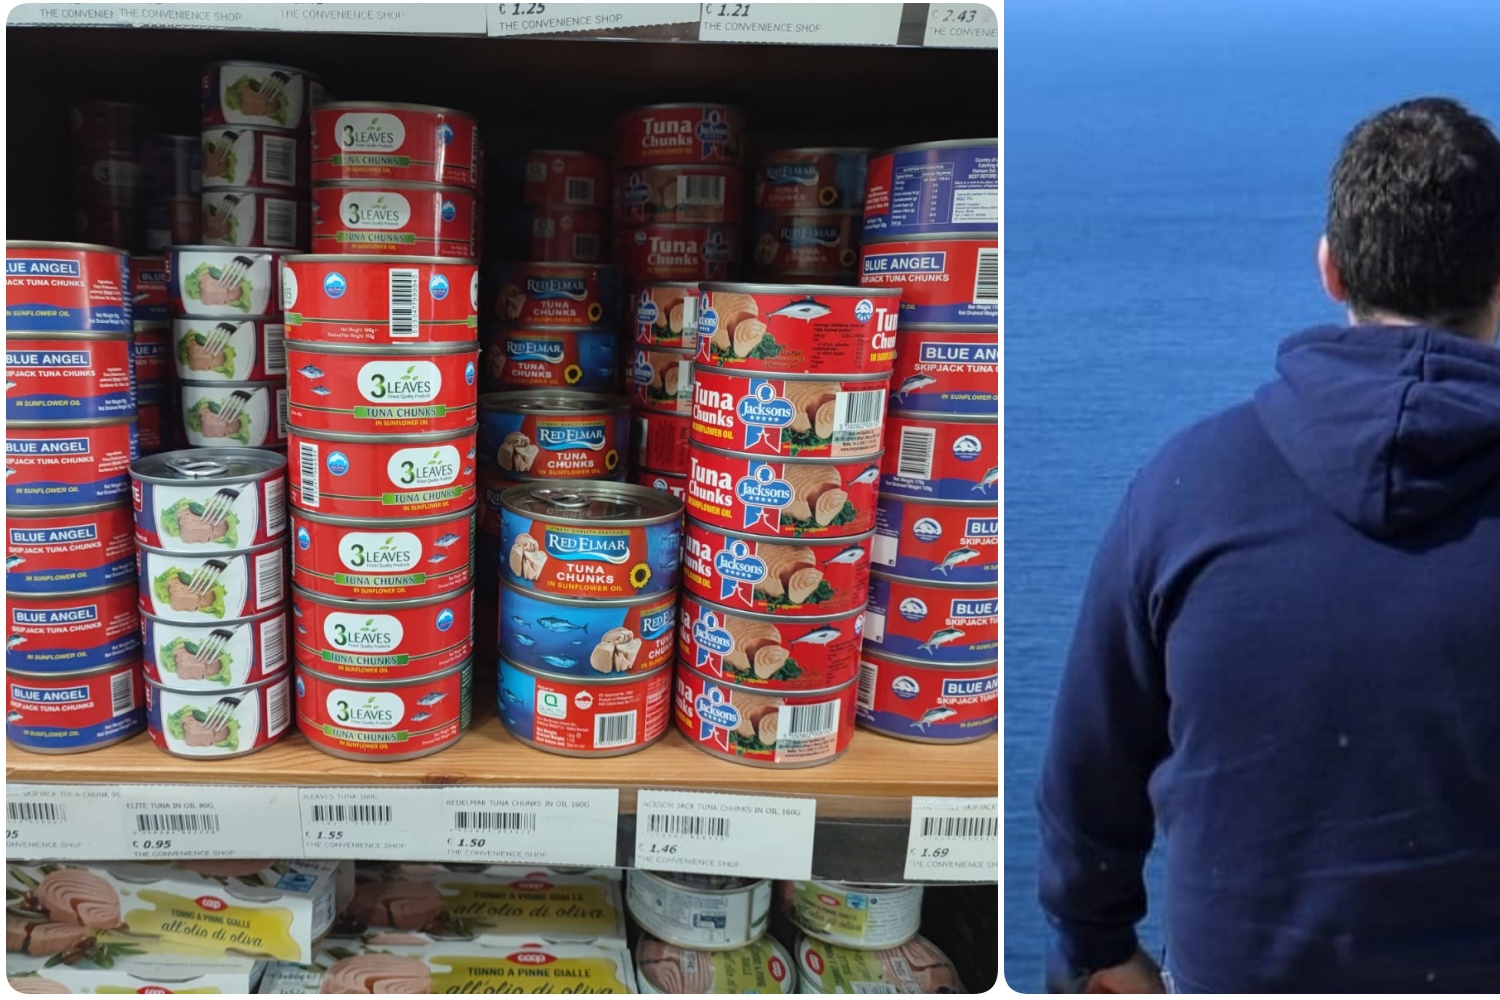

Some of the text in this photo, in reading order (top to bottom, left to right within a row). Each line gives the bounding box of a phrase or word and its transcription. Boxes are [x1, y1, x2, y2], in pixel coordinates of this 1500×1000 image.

[511, 2, 546, 16] 1.25
[717, 4, 751, 17] 1.21
[703, 22, 723, 32] THE
[725, 22, 793, 33] CONVENIENCE
[348, 202, 399, 225] 3 LEAVES
[865, 256, 940, 271] BLUE ANGEL
[885, 273, 950, 283] TUNA CHUNKS
[6, 353, 88, 364] BLUE ANGEL
[371, 373, 431, 398] 3 LEAVES
[694, 382, 734, 411] Tuna
[365, 407, 436, 418] TUNA CHUNKS
[742, 401, 792, 418] Jacksons
[693, 405, 734, 428] Chunks
[556, 452, 588, 460] TUNA
[546, 459, 595, 469] CHUNKS
[742, 481, 790, 499] Jacksons
[13, 528, 94, 542] BLUE ANGEL
[350, 544, 410, 567] 3 LEAVES
[566, 563, 605, 574] TUNA
[343, 575, 415, 586] TUNA CHUNKS
[556, 571, 615, 584] CHUNKS
[557, 582, 623, 592] SUNFLOWER OIL
[511, 800, 542, 808] CHUNKS
[143, 839, 172, 849] 0.95
[457, 838, 486, 848] 1.50
[648, 844, 678, 854] 1.46
[211, 925, 227, 942] di
[229, 929, 264, 948] oliva
[468, 968, 592, 978] TONNO PINNE GIALLE
